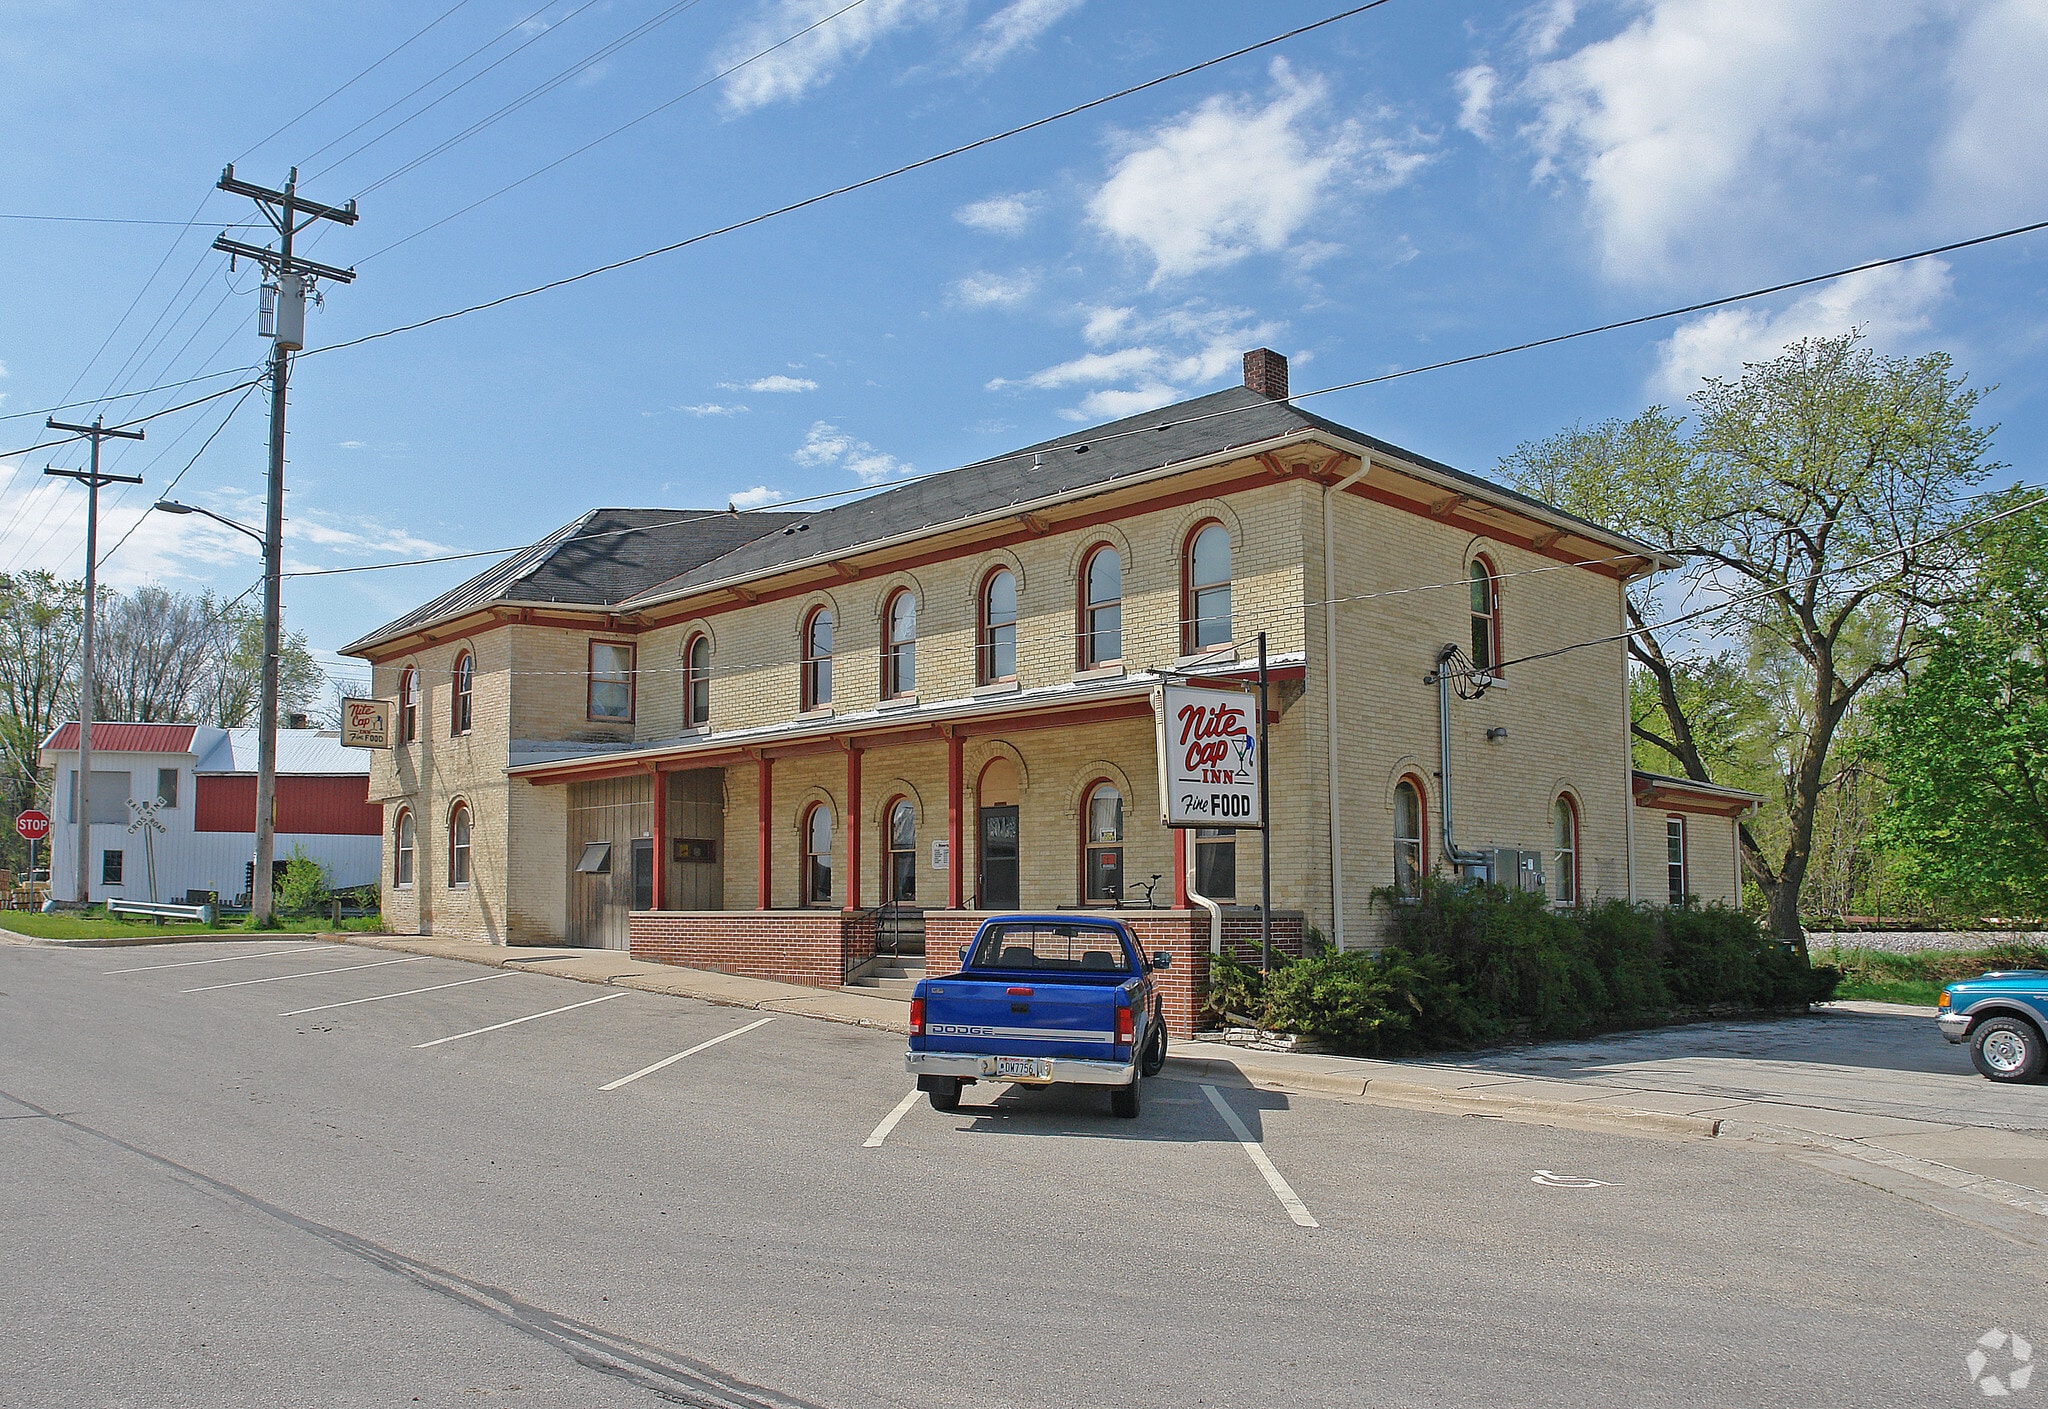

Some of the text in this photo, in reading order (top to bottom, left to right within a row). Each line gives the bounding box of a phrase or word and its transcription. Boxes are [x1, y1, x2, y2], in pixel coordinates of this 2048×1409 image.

[349, 704, 376, 717] Nite
[352, 716, 370, 728] Cap
[1178, 703, 1247, 745] Nite
[1185, 740, 1228, 771] Cap
[1202, 769, 1234, 785] INN
[1181, 794, 1250, 817] Fine FOOD
[19, 819, 48, 831] STOP
[932, 1025, 994, 1036] DODGE
